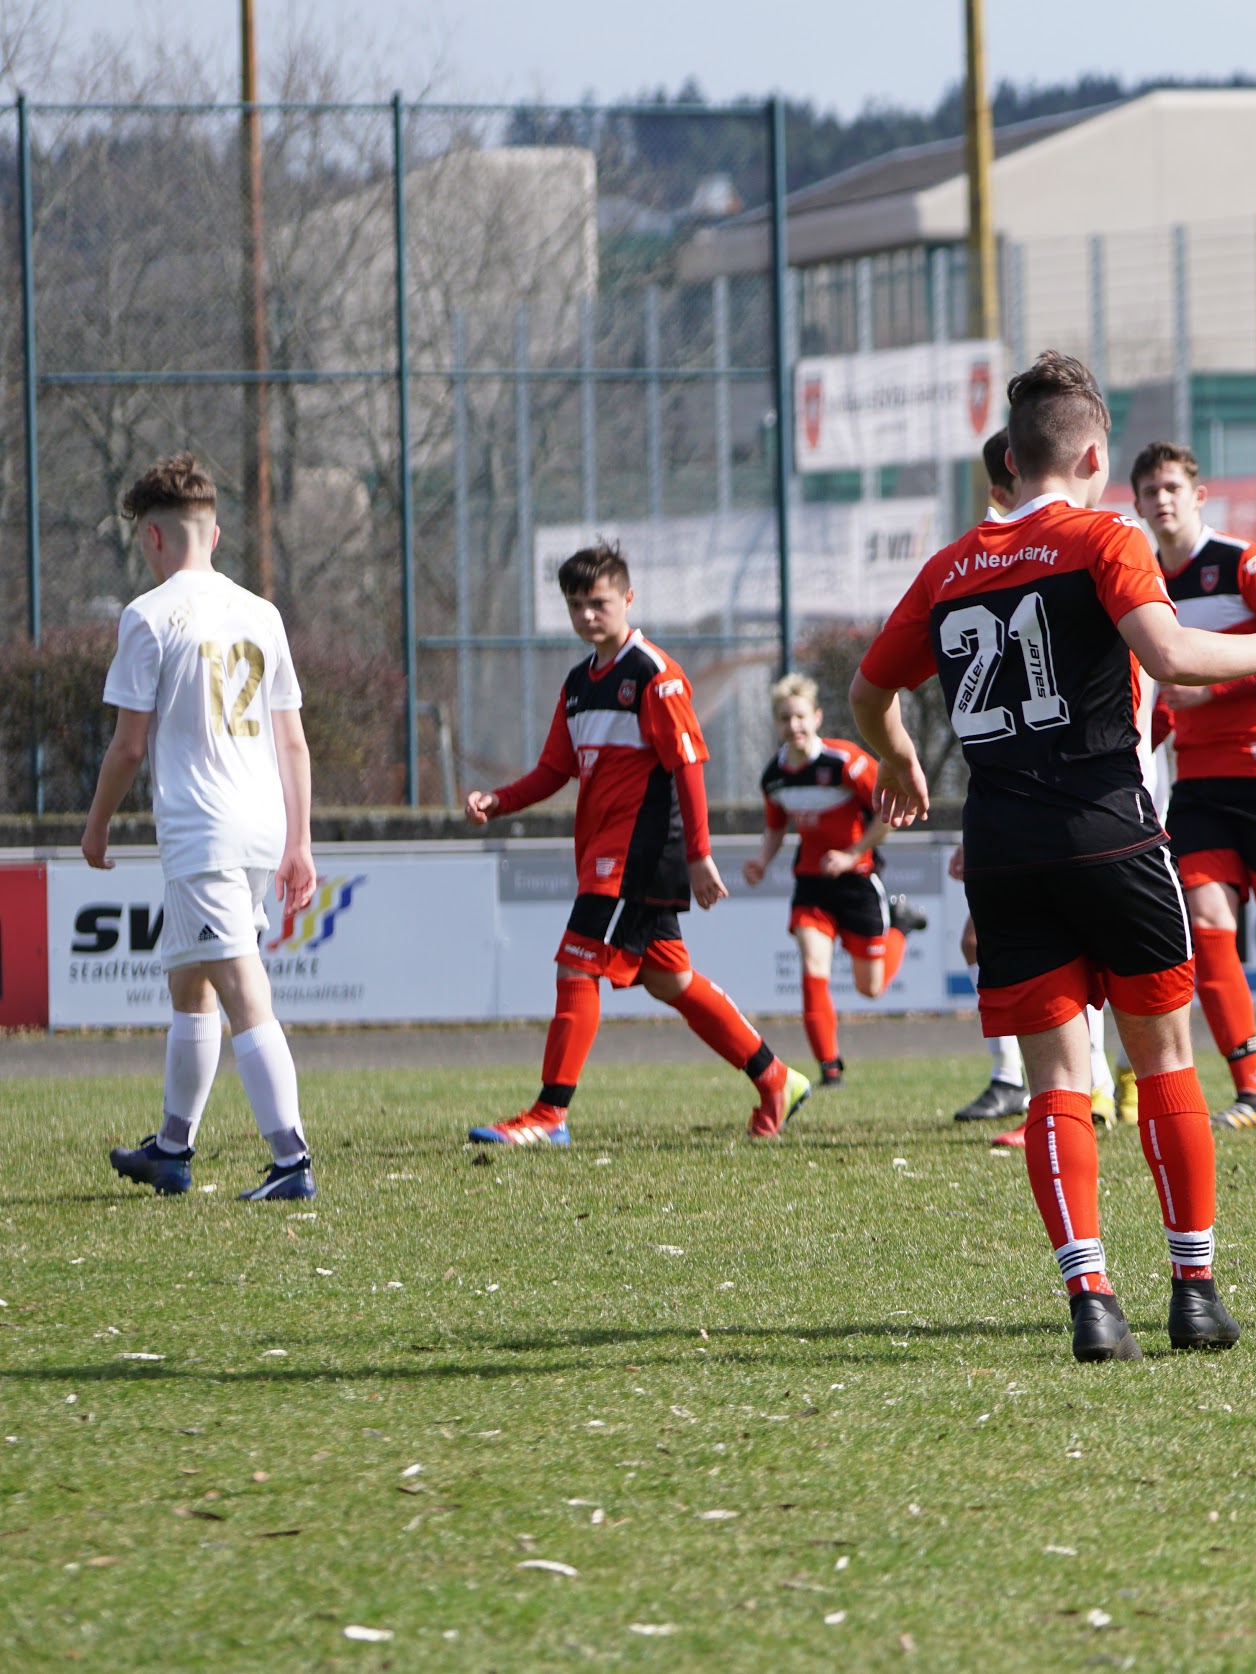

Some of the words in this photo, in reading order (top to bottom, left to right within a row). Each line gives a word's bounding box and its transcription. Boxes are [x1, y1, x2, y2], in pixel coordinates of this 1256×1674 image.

[941, 557, 969, 590] SV
[974, 545, 1059, 571] Neumarkt
[199, 637, 266, 737] 12
[939, 591, 1071, 746] 21
[957, 655, 985, 714] saller
[1027, 638, 1047, 699] saller
[68, 957, 168, 983] stadtwe
